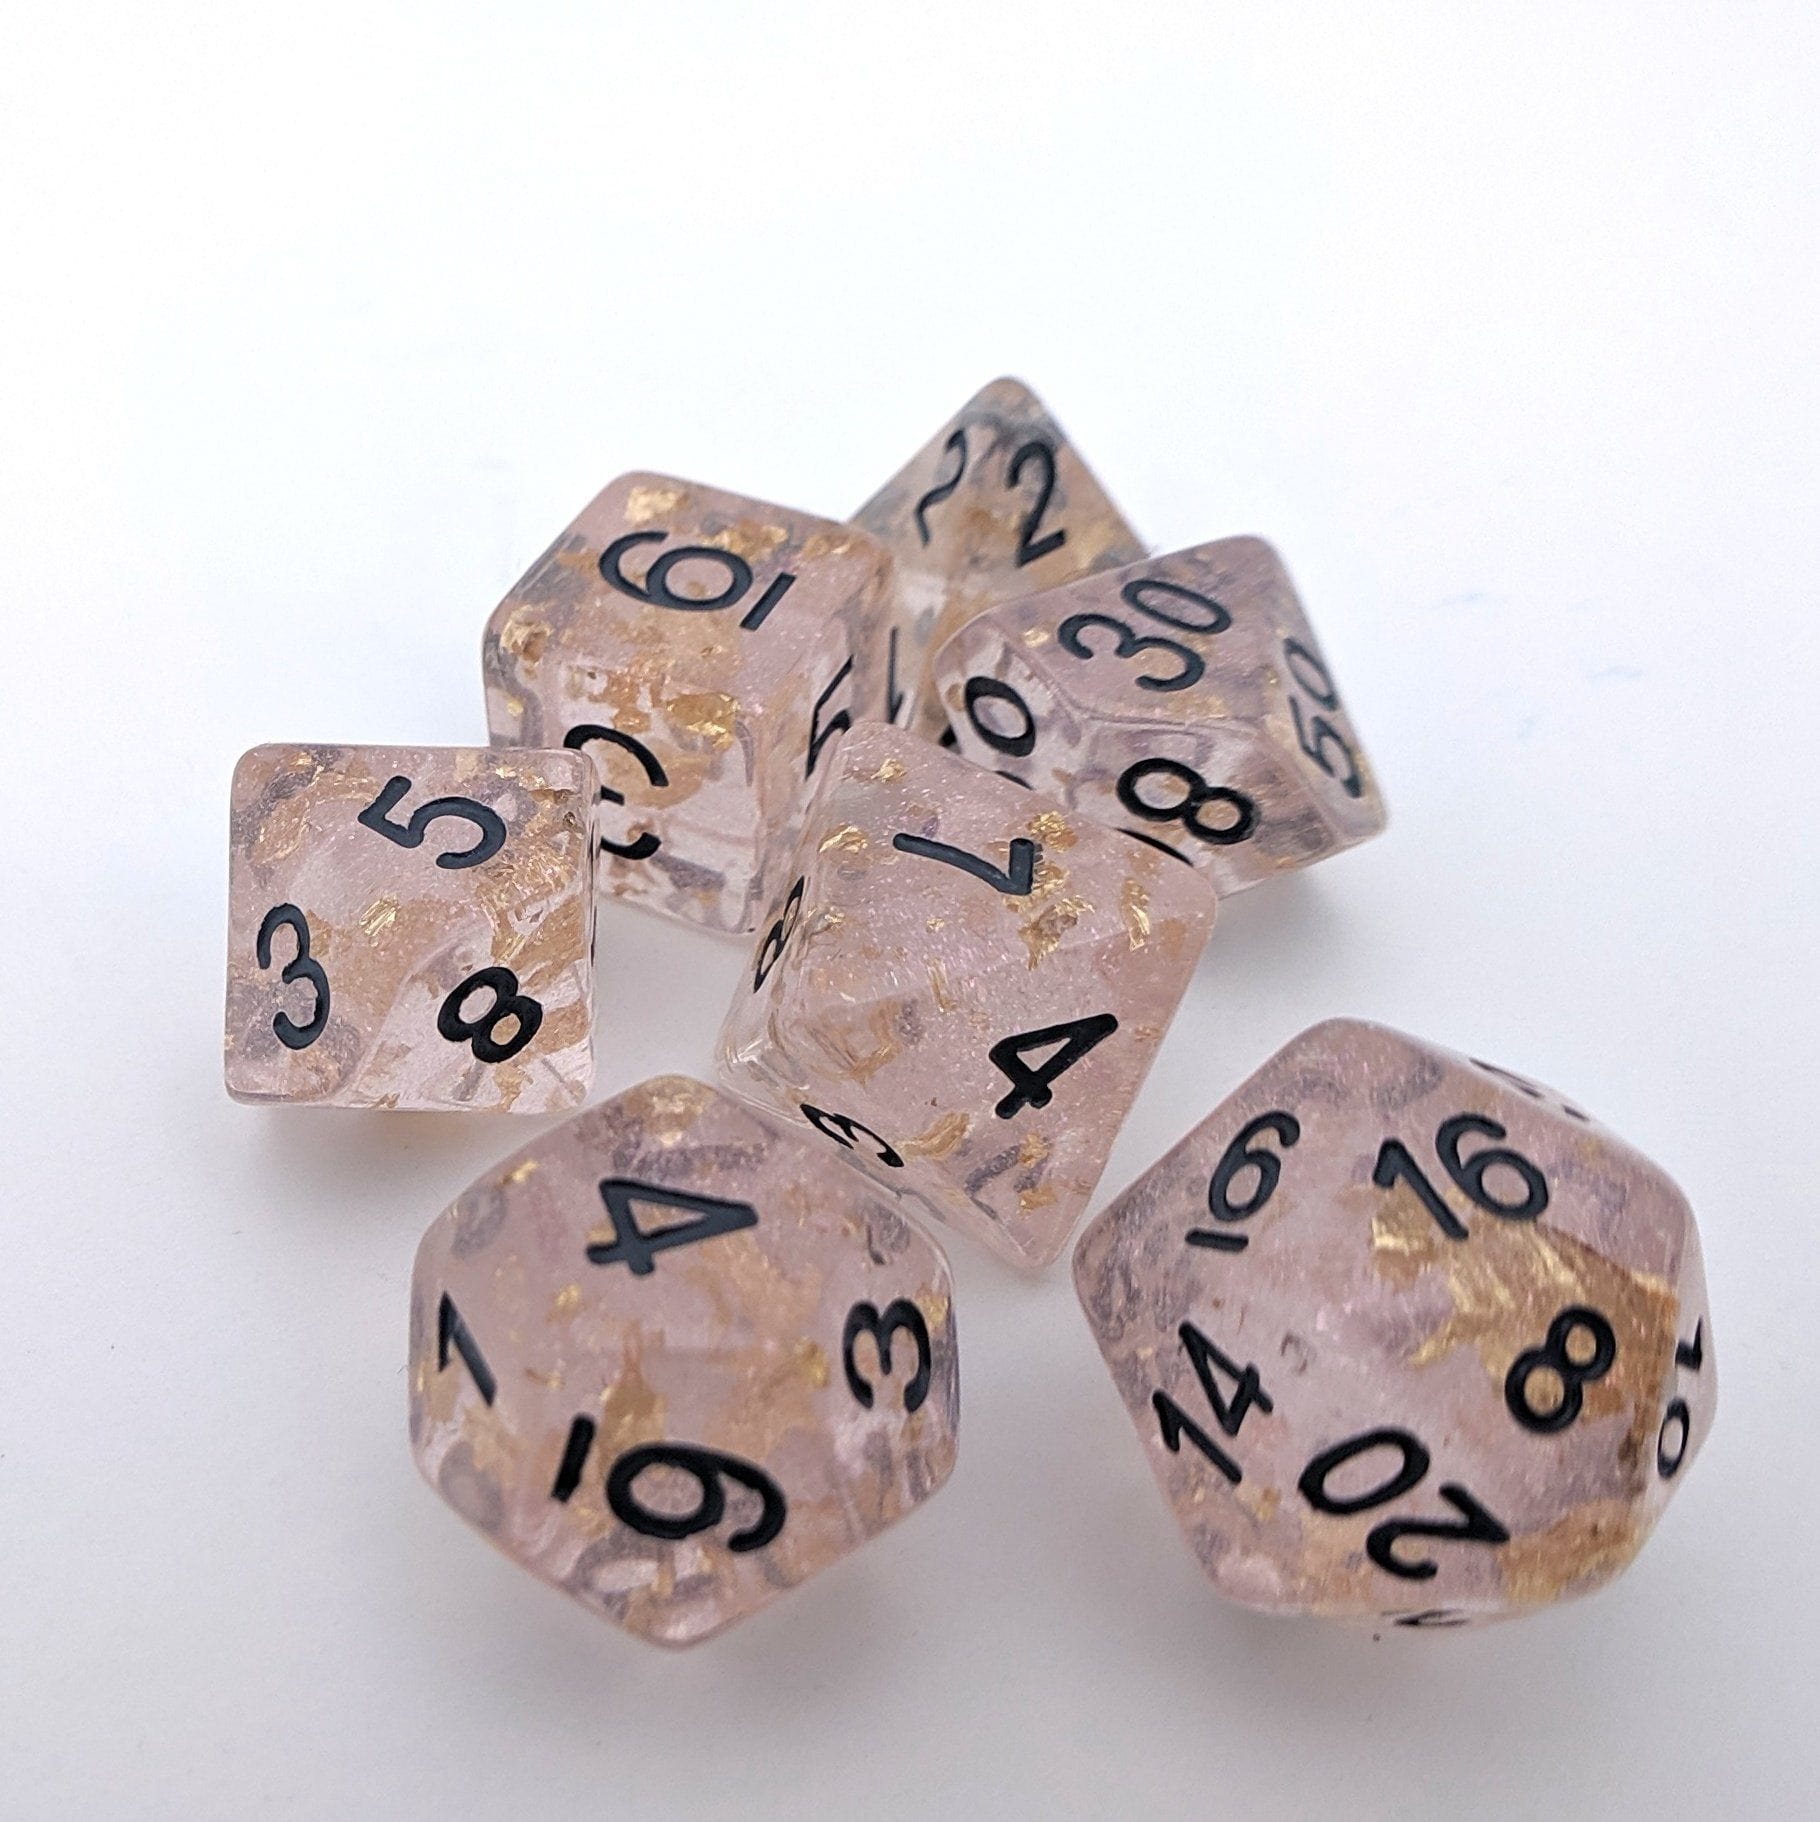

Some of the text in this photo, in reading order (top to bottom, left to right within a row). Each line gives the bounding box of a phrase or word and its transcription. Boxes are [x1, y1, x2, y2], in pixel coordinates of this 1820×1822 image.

[1006, 438, 1067, 569] 2
[598, 531, 797, 631] 6
[1058, 578, 1232, 693] 30
[1284, 637, 1362, 798] 50
[357, 775, 507, 870] 5
[892, 832, 1036, 891] 7
[256, 902, 331, 1051] 3
[753, 875, 805, 994] 8
[437, 966, 544, 1064] 8
[988, 1013, 1119, 1120] 4
[586, 1177, 759, 1277] 4
[1184, 1110, 1301, 1253] 6
[1372, 1113, 1550, 1242] 16
[842, 1298, 933, 1415] 3
[1151, 1321, 1274, 1486] 14
[1504, 1304, 1617, 1436] 8
[550, 1414, 788, 1555] 6
[1297, 1427, 1511, 1582] 20
